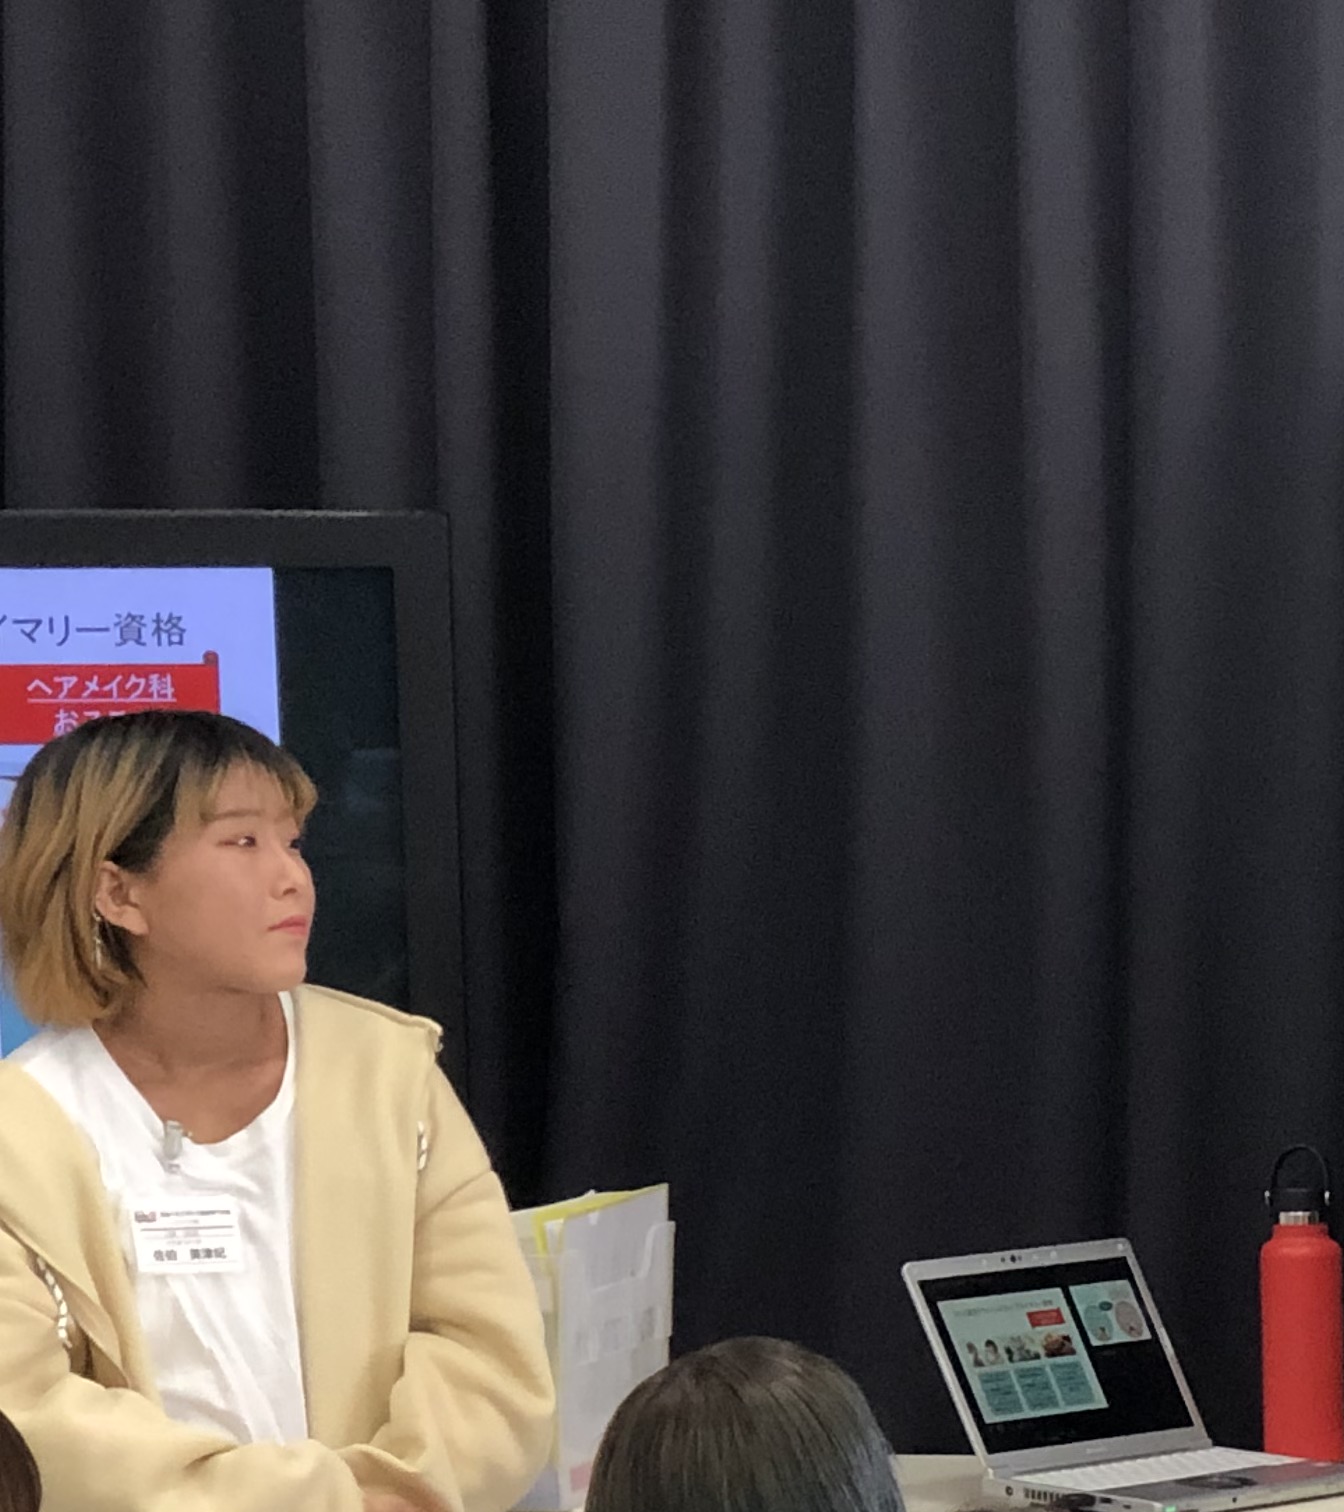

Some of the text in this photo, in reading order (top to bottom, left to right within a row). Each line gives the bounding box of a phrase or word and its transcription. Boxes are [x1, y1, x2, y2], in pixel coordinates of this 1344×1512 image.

[0, 612, 187, 647] マリー資格
[27, 673, 175, 702] ヘアメイク科
